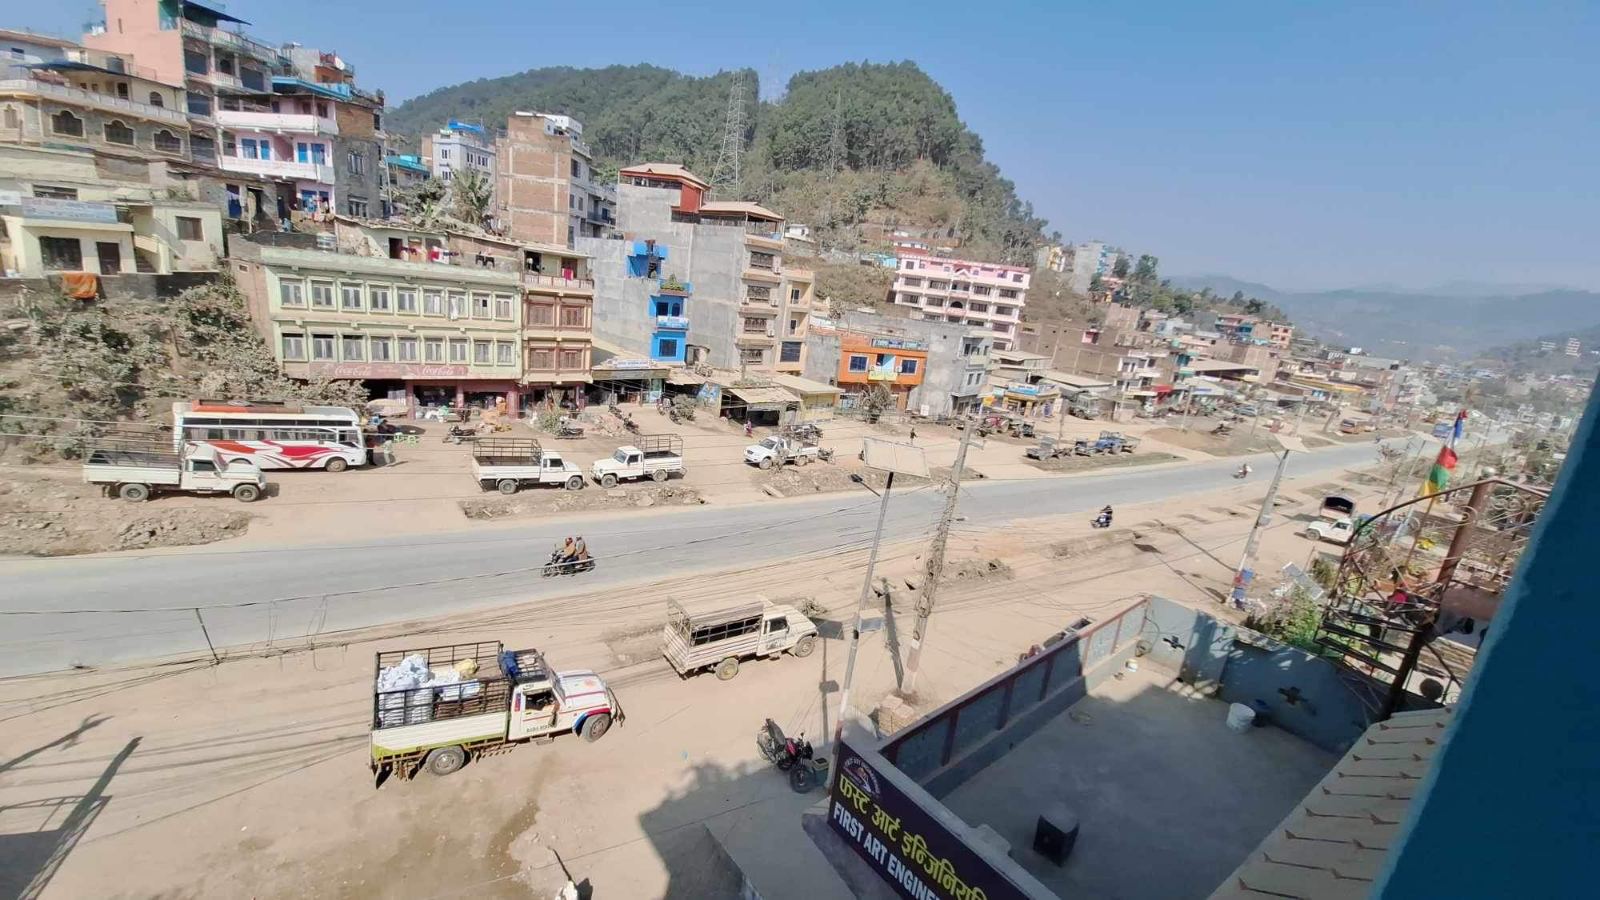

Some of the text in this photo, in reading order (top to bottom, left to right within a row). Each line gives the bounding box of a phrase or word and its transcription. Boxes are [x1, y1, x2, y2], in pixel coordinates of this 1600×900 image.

[833, 801, 941, 900] FIRST ART ENGINE
[871, 804, 901, 842] आर्ट
